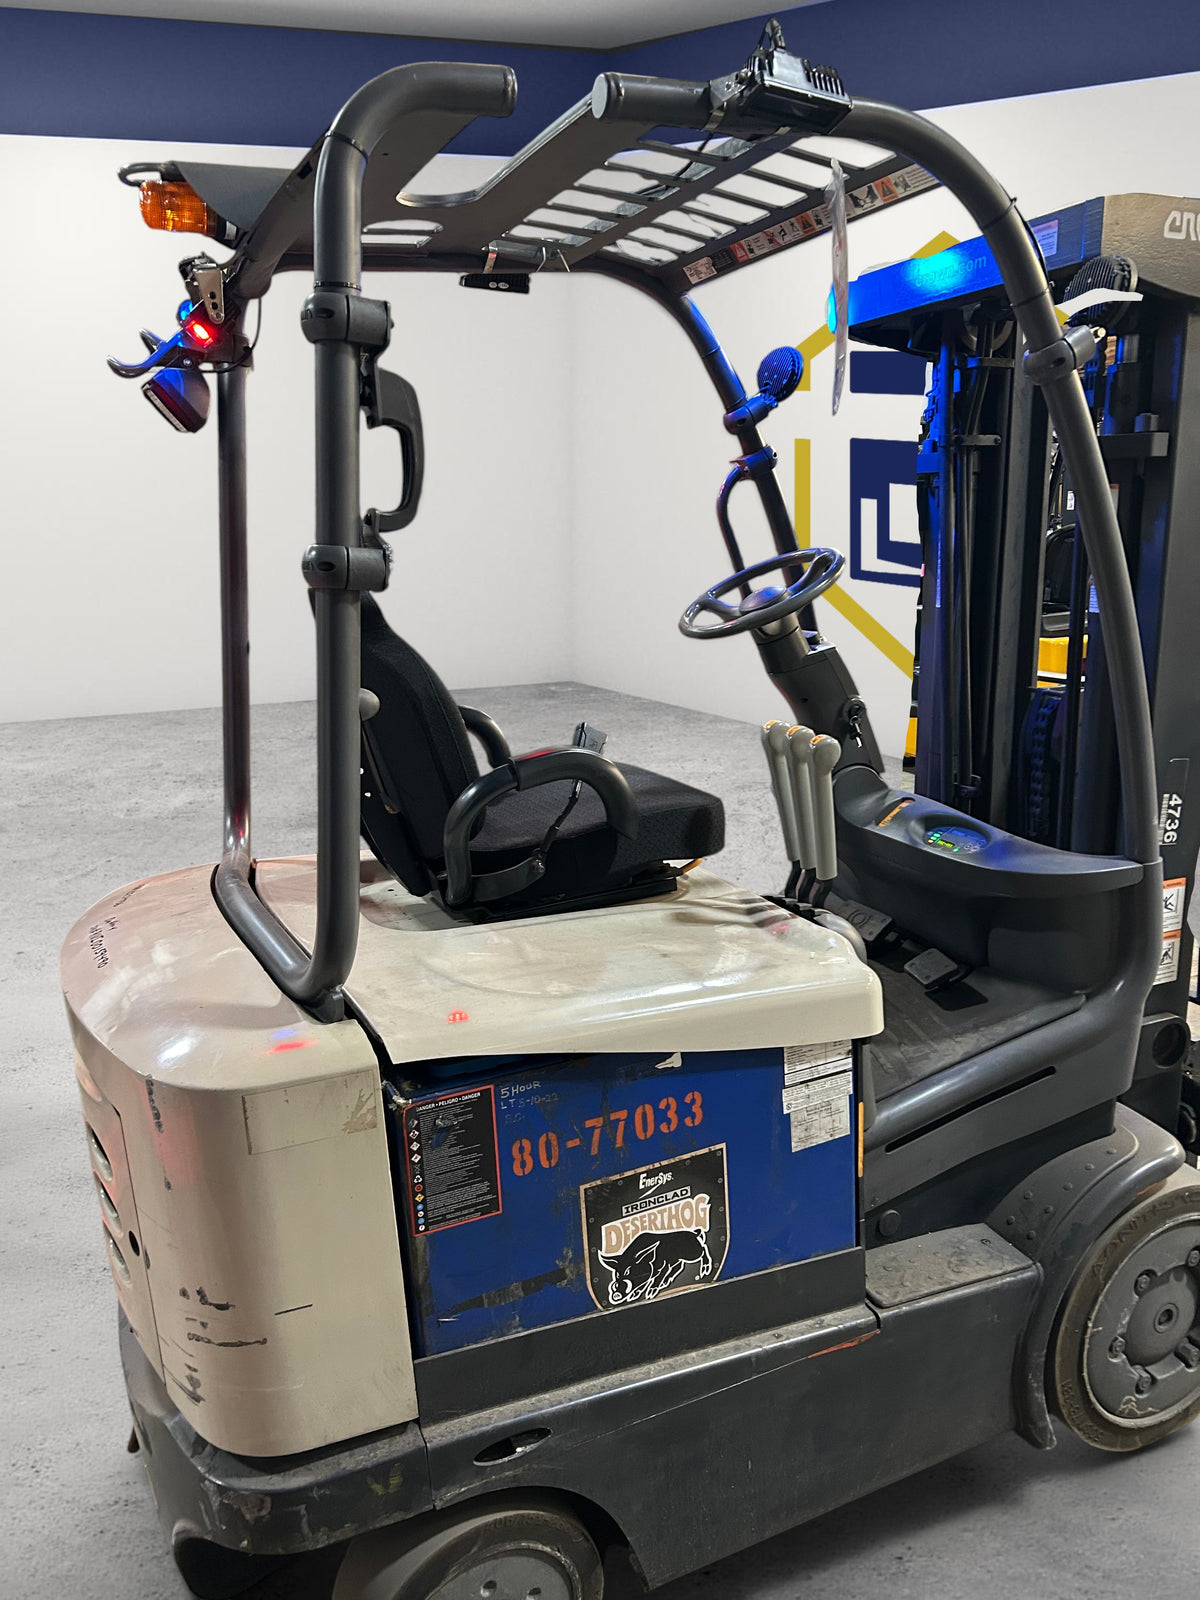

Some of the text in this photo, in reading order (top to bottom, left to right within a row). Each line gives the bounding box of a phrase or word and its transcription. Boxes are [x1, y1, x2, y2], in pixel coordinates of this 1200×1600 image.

[1163, 793, 1183, 843] 4736
[415, 1092, 481, 1112] DANGER PELIGRO DANGER
[500, 1087, 510, 1099] 5
[511, 1090, 704, 1177] 80-77033
[639, 1171, 673, 1190] EnerSys
[623, 1188, 689, 1215] IRONCLAD
[603, 1194, 711, 1255] DESERTHOG
